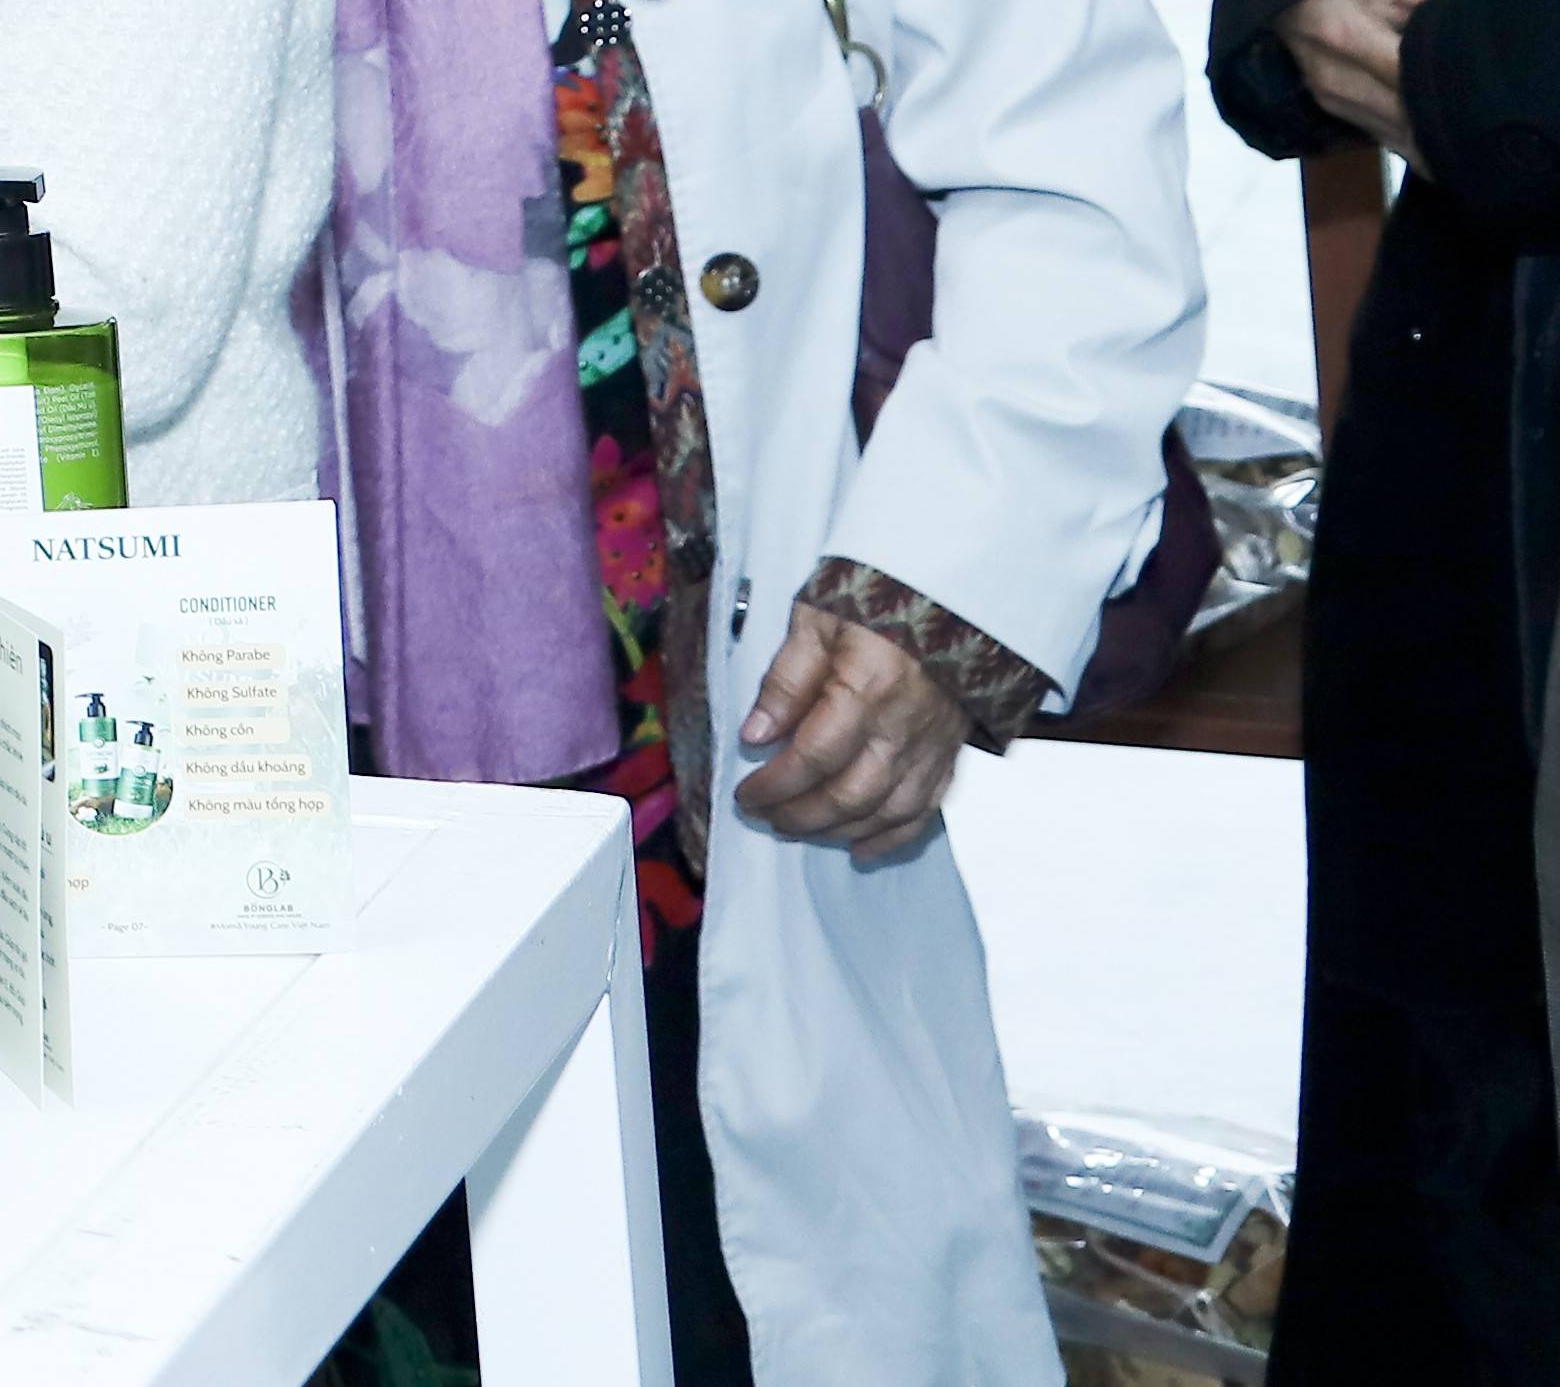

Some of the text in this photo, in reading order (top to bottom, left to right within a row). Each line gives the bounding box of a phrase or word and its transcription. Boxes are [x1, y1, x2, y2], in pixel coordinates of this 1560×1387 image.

[32, 534, 184, 562] NATSUMI
[179, 595, 277, 613] CONDITIONER
[182, 649, 223, 664] Không
[187, 687, 277, 702] Không Sulfate
[185, 724, 227, 739] Không
[186, 761, 228, 777] Không
[188, 798, 230, 814] Không
